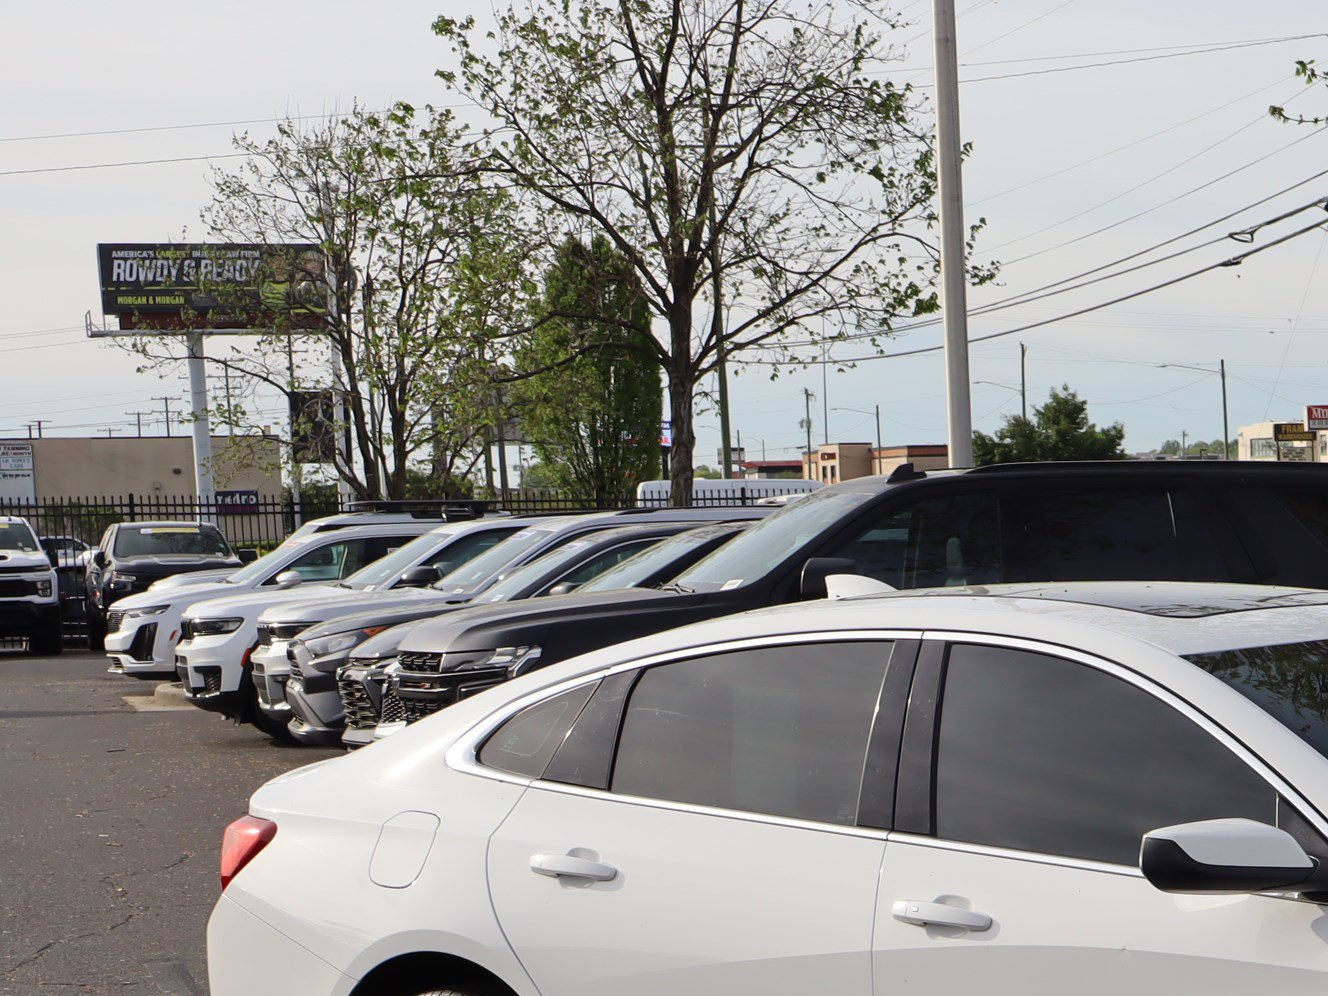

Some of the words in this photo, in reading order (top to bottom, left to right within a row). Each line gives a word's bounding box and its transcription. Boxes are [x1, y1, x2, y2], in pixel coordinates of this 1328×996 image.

[111, 250, 155, 258] AMERICA'S
[112, 259, 181, 282] ROWDY
[117, 295, 147, 305] MORGAN
[148, 296, 155, 305] &
[155, 295, 185, 305] MORGAN
[1281, 424, 1305, 434] FRAM
